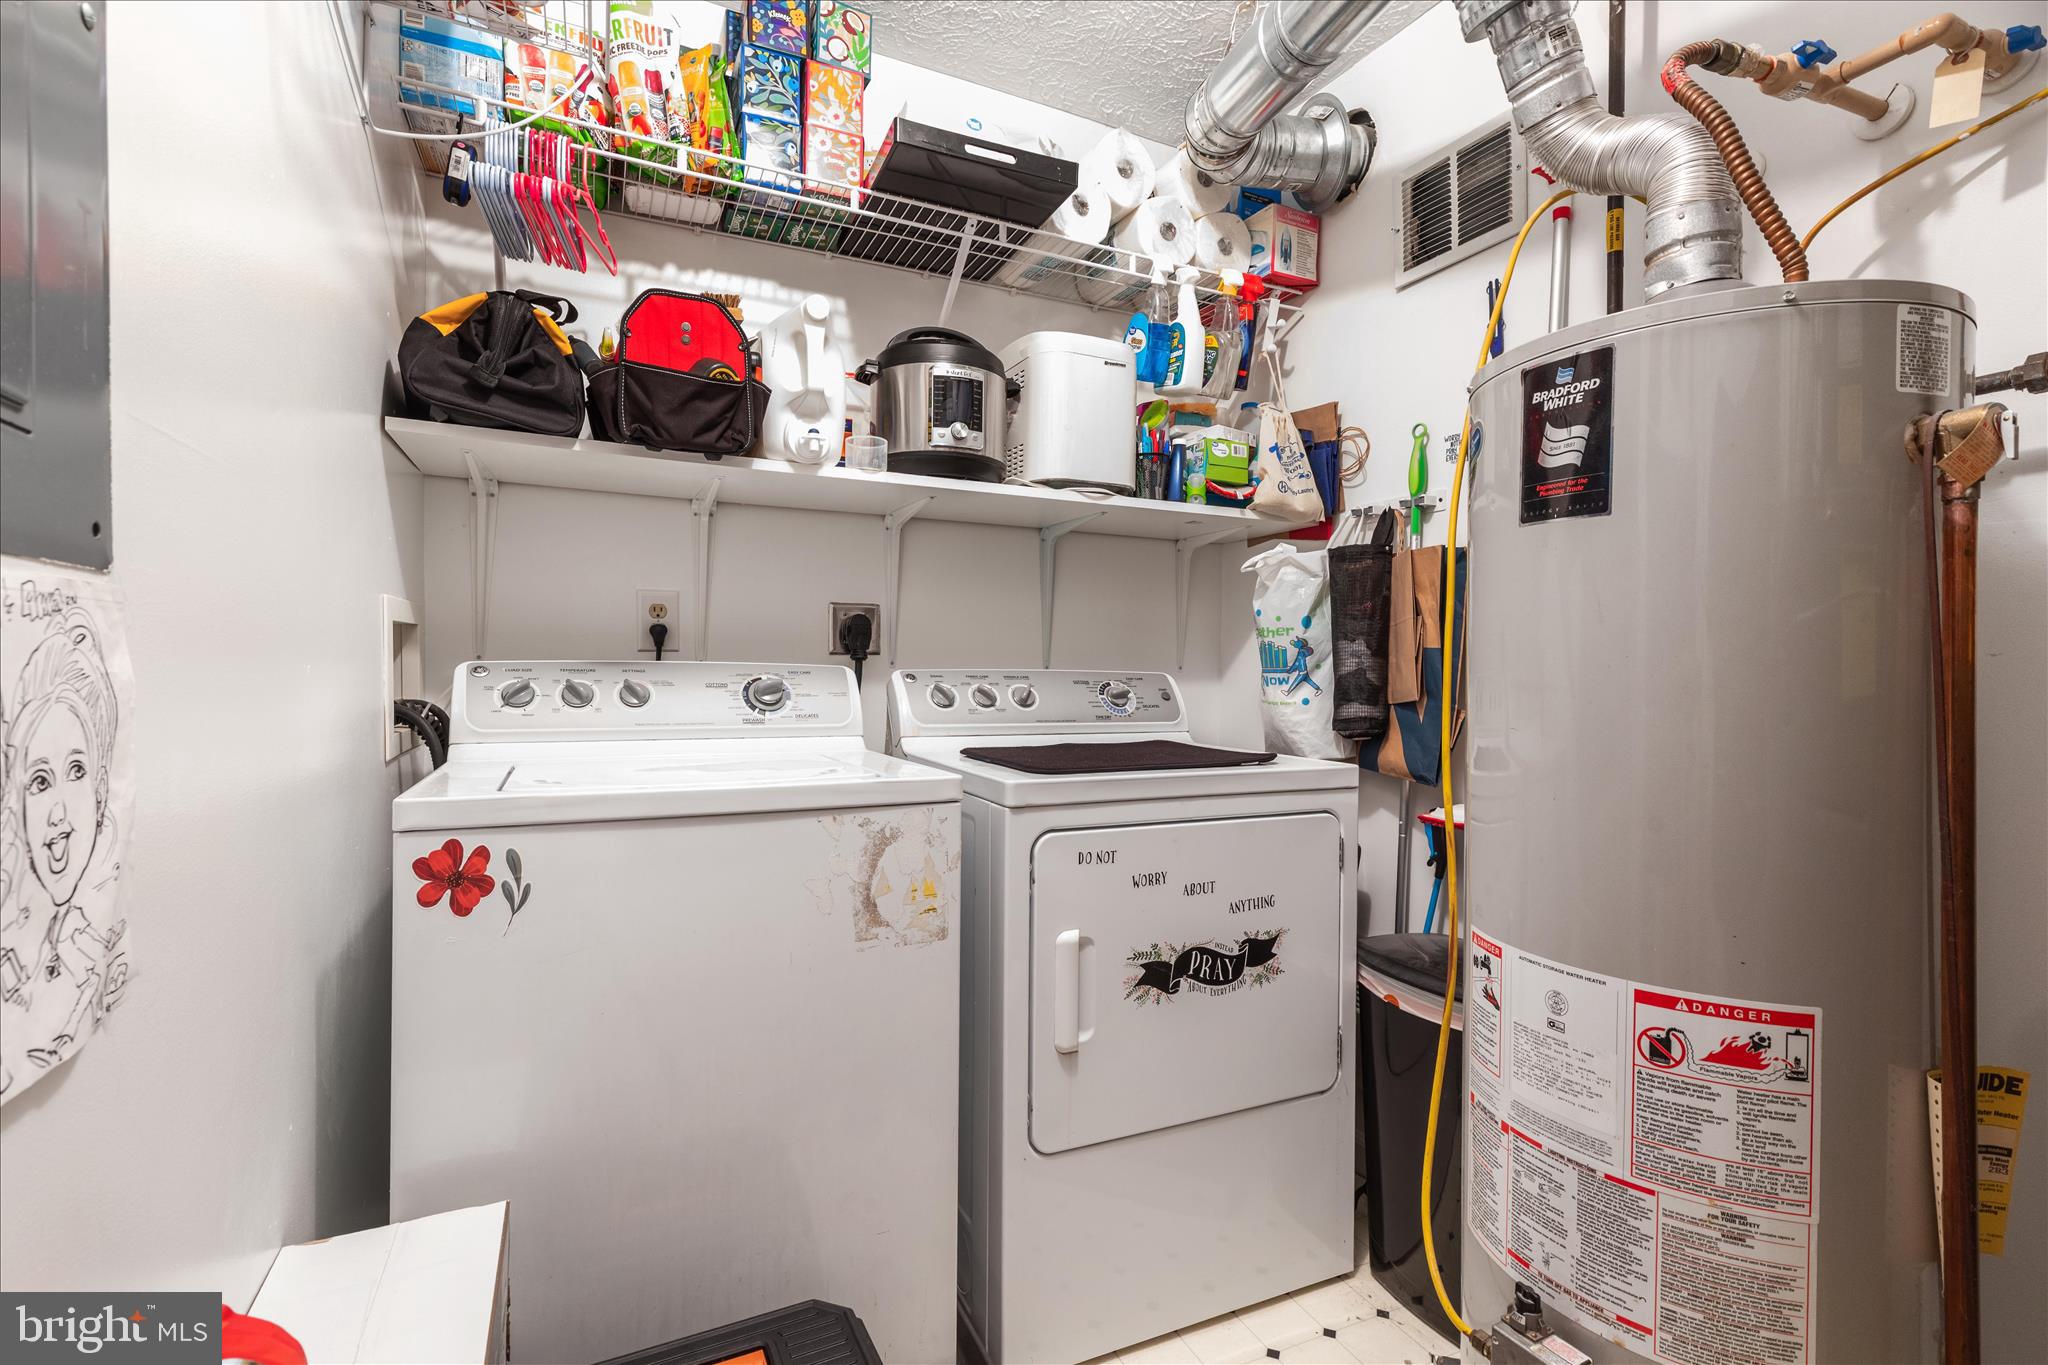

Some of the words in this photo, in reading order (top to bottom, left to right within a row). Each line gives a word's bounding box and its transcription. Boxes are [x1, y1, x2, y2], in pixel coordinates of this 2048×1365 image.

[647, 48, 668, 57] POPS
[1532, 378, 1600, 405] BRADFORD
[1543, 392, 1584, 412] WHITE
[1567, 485, 1584, 493] Trade
[1078, 851, 1092, 865] DO
[1096, 850, 1117, 865] NOT
[1132, 871, 1168, 889] WORRY
[1183, 880, 1216, 896] ABOUT
[1228, 894, 1276, 914] ANYTHING
[1214, 942, 1234, 954] INSTEAD
[1477, 936, 1501, 956] DANGER
[1188, 950, 1237, 981] PRAY
[1519, 955, 1542, 968] AUTOMATIC
[1542, 963, 1564, 975] STORAGE
[1566, 971, 1584, 980] WATER
[1584, 976, 1607, 986] HEATER
[1187, 981, 1207, 994] ABOUT
[1210, 975, 1247, 997] EVERYTHING
[1692, 1002, 1771, 1022] DANGER
[1700, 1067, 1734, 1078] Flammable
[1736, 1073, 1758, 1081] Vapors
[1681, 1080, 1712, 1090] flammable
[1994, 1109, 2019, 1120] Heater
[1720, 1211, 1748, 1221] WARNING
[1721, 1216, 1737, 1224] YOUR
[1738, 1220, 1760, 1229] SAFETY
[1720, 1233, 1746, 1243] WARNING
